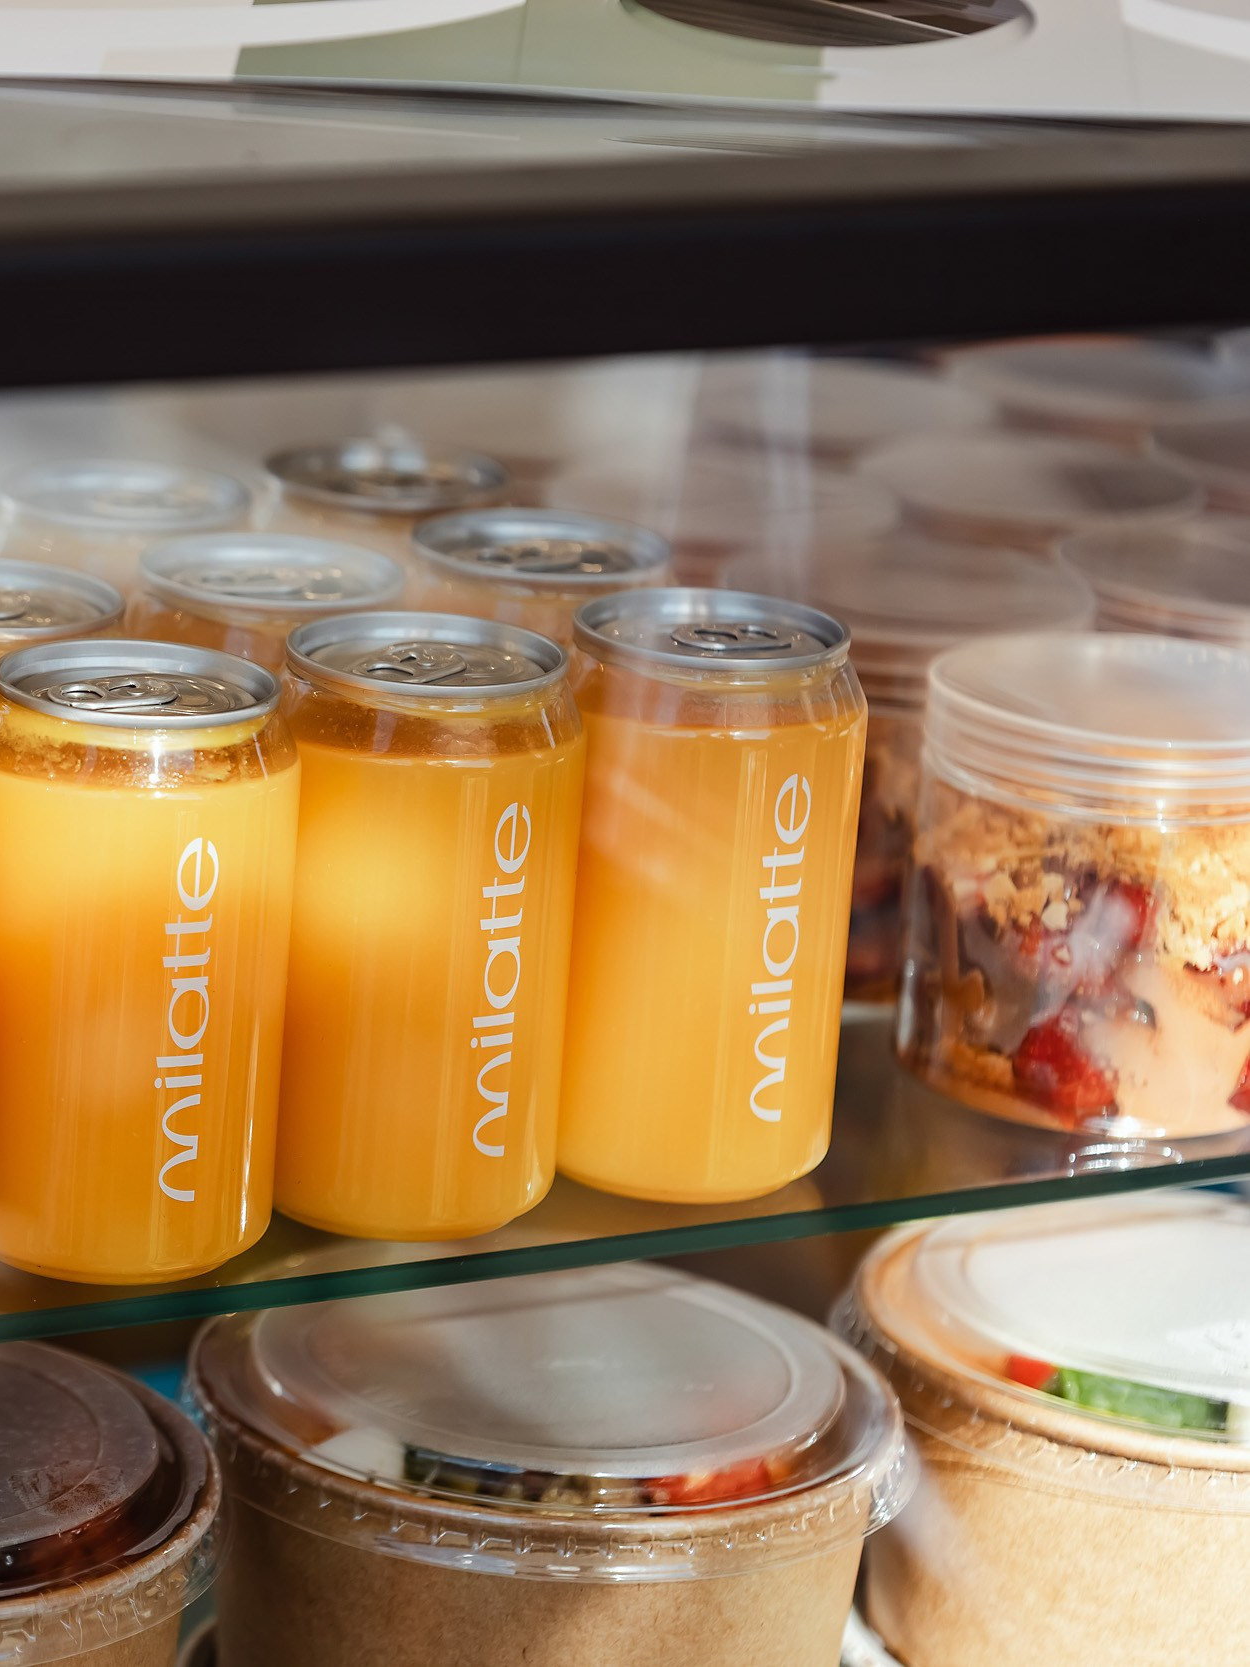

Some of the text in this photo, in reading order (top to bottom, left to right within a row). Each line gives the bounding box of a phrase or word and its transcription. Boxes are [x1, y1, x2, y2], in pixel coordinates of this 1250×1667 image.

[154, 837, 219, 1201] milatte
[470, 802, 531, 1157] milatte
[748, 773, 811, 1120] milatte
